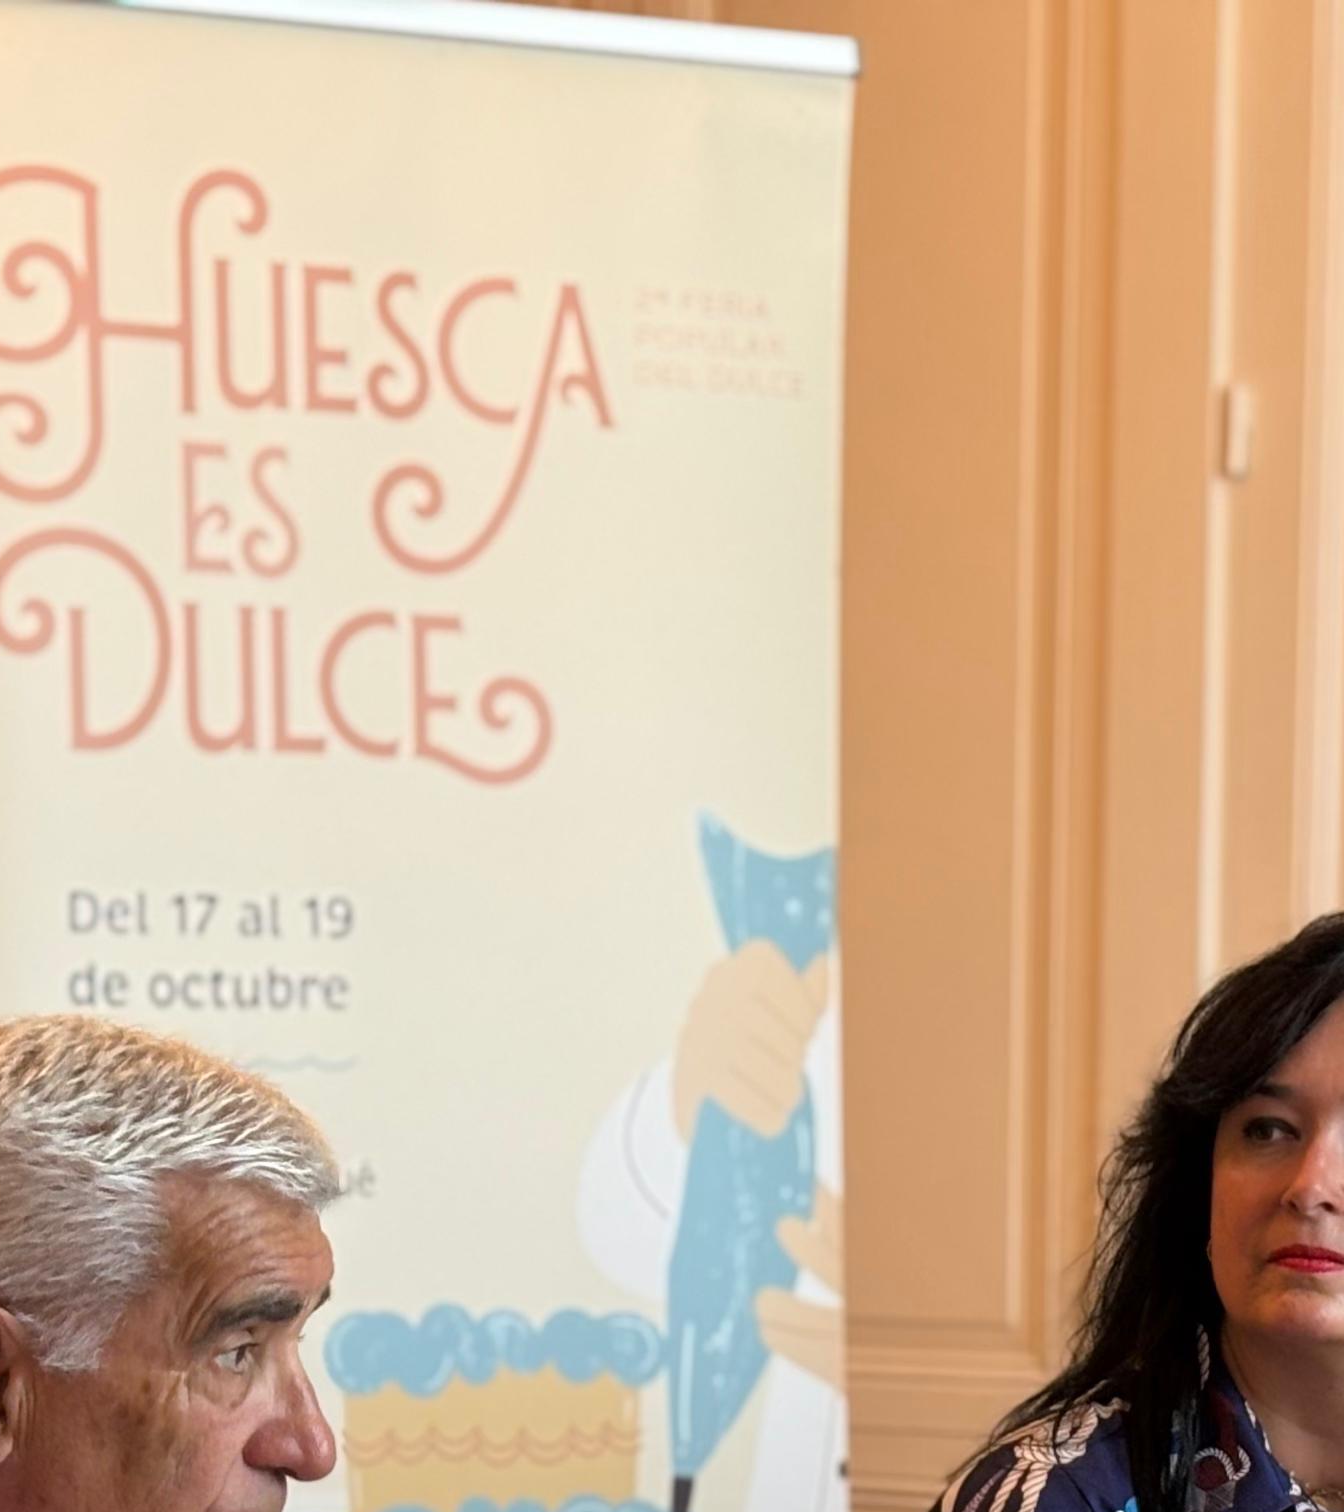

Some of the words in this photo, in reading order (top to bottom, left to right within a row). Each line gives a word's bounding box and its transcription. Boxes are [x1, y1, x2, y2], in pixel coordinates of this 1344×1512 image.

[632, 322, 787, 358] POPULAR
[706, 364, 806, 401] DULCE
[181, 441, 299, 578] ES
[67, 888, 148, 935] Del
[171, 893, 219, 936] 17
[238, 891, 282, 938] al
[305, 896, 355, 939] 19
[67, 962, 130, 1007] de
[148, 966, 350, 1010] octubre
